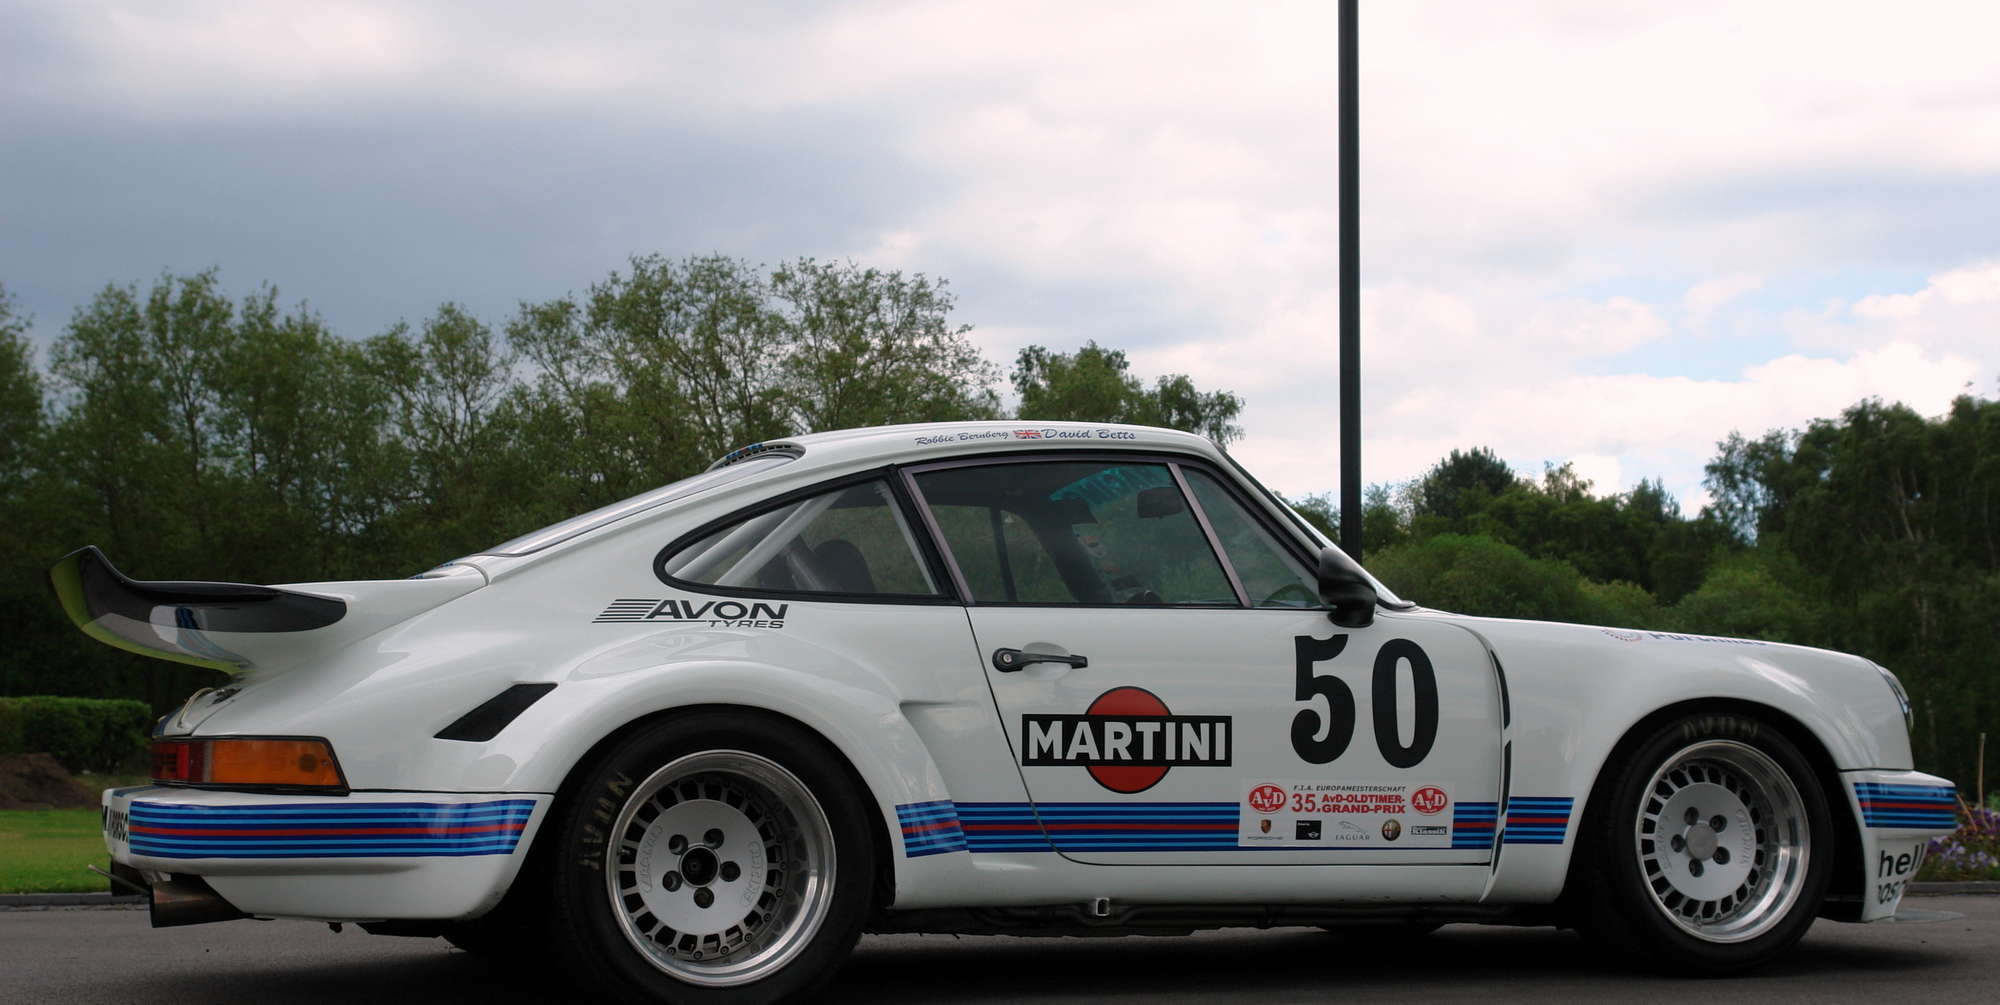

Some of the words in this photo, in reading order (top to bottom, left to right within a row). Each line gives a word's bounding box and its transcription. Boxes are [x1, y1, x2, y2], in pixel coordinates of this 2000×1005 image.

[914, 434, 954, 446] Robbie
[1041, 428, 1091, 439] David
[1096, 428, 1136, 440] Betts
[645, 600, 788, 620] AVON
[708, 620, 784, 629] TYRES
[1290, 633, 1439, 769] 50
[1028, 720, 1226, 761] MARTINI
[1292, 793, 1320, 812] 35.
[1322, 804, 1406, 813] GRAND-PRIX
